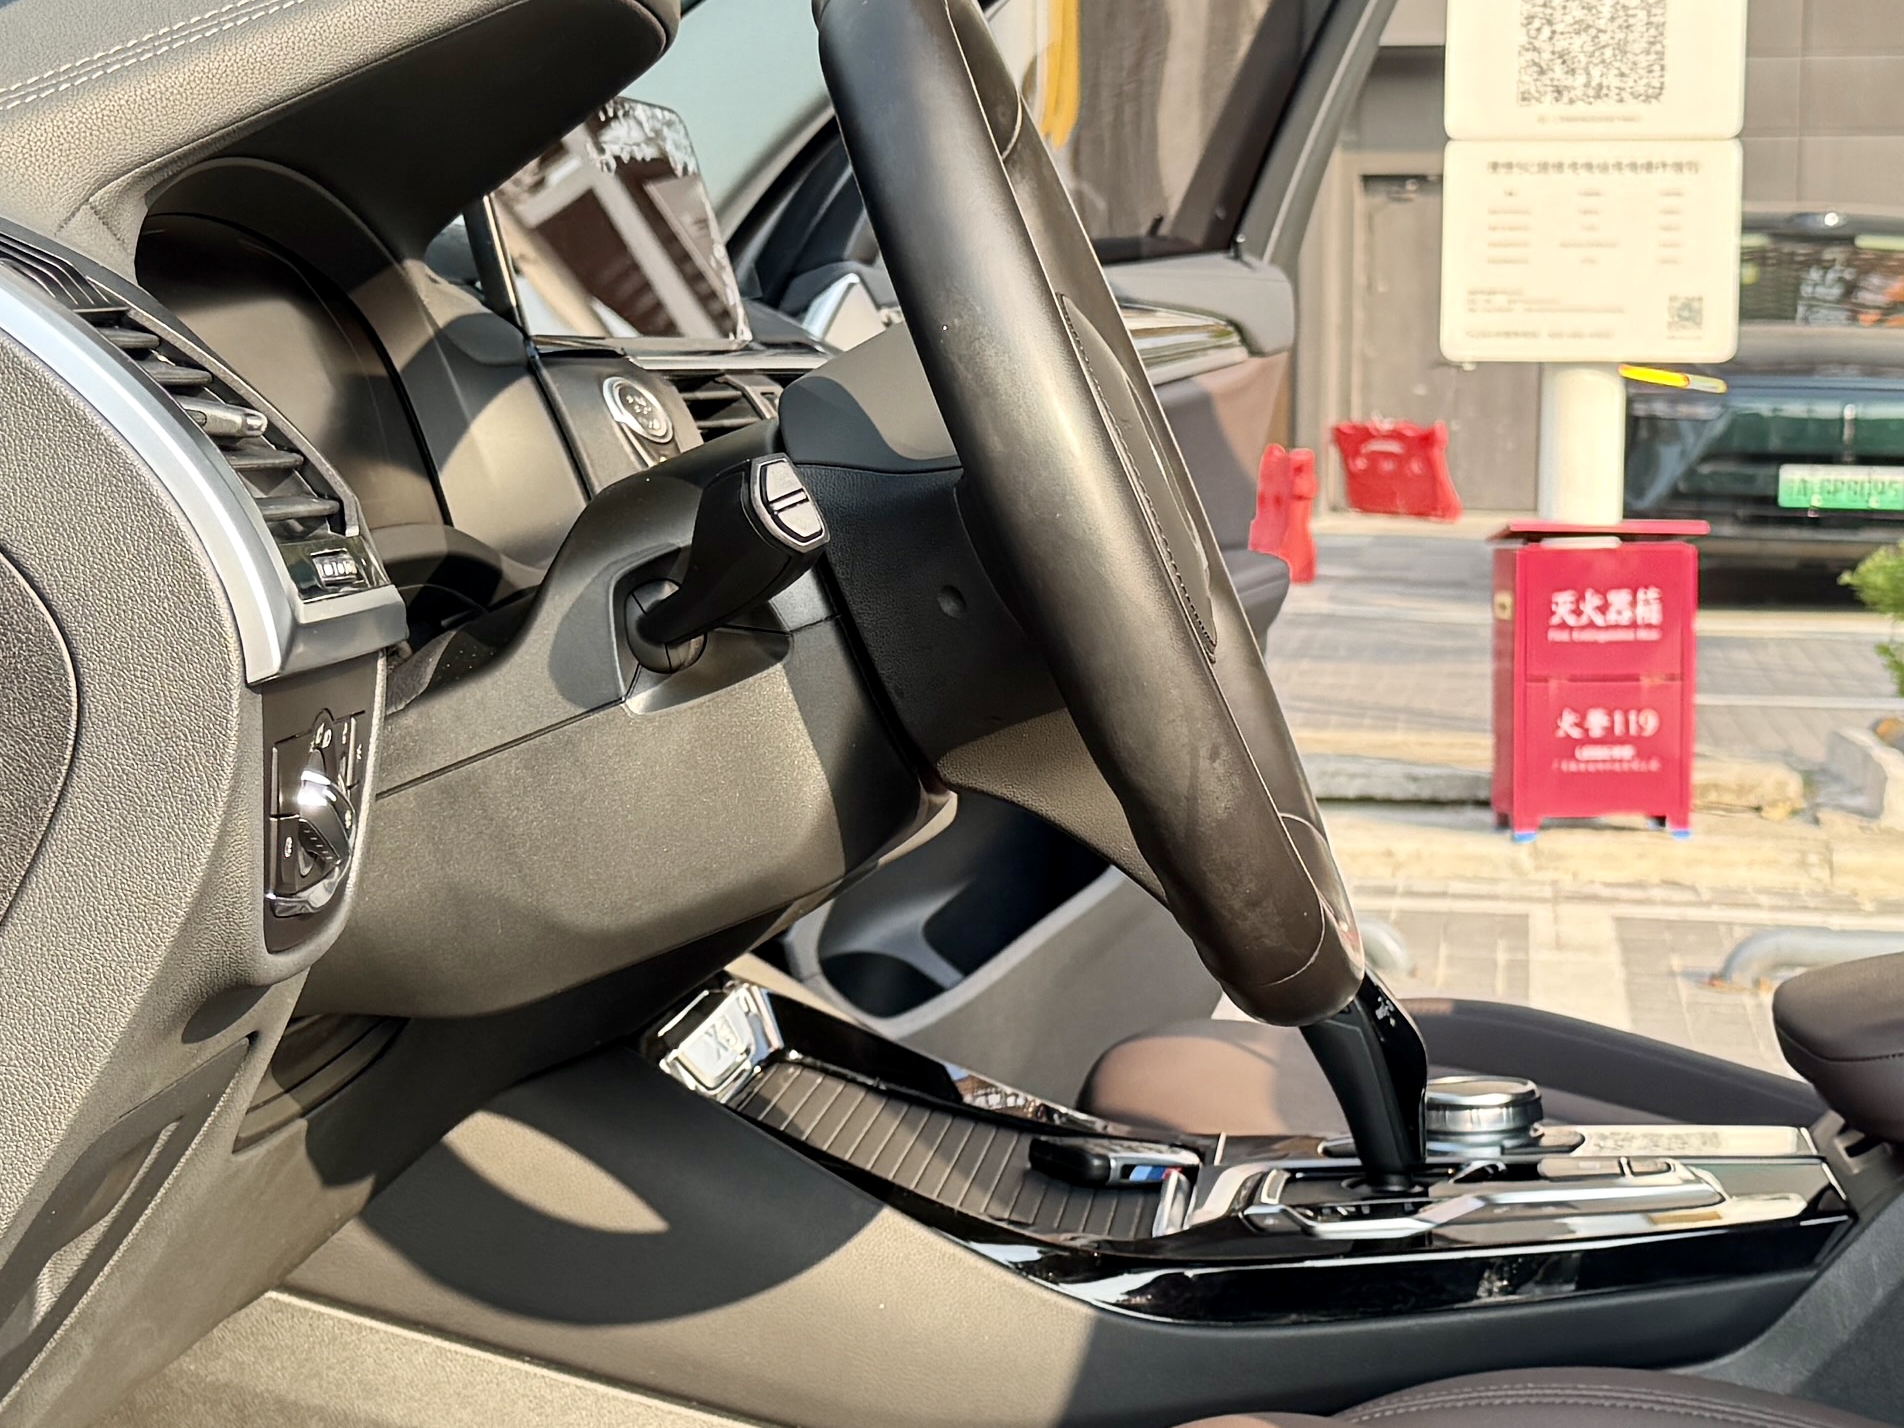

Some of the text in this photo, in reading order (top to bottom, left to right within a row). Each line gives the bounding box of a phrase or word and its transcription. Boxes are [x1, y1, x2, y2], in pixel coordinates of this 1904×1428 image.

[1548, 585, 1663, 627] 灭火器箱
[1553, 707, 1660, 740] 火警119
